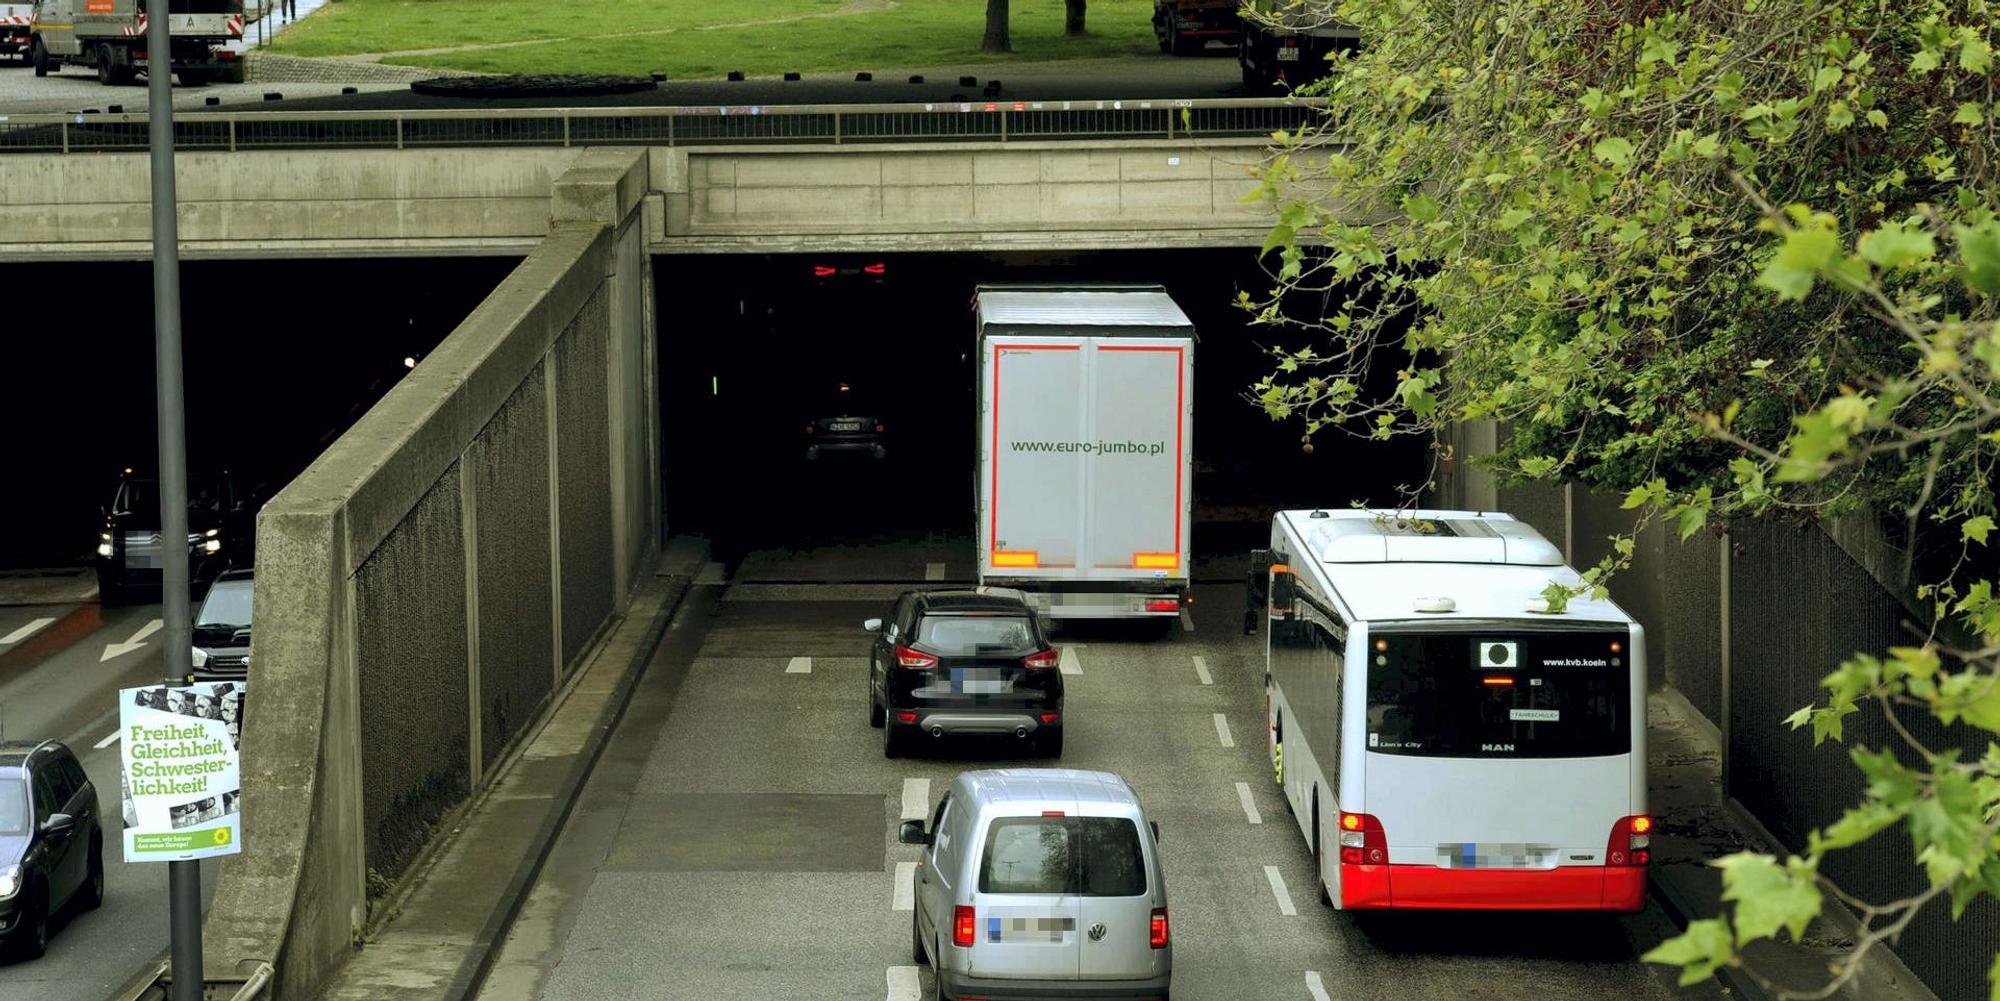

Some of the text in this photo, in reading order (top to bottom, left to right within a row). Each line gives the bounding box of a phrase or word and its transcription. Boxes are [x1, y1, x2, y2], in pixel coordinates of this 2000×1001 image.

[1011, 440, 1165, 455] www.euro-jumbo.pl
[1543, 659, 1606, 667] www.kvb.koeln
[130, 723, 208, 740] Freiheit,
[130, 738, 227, 759] Gleichheit,
[131, 759, 232, 777] Schwester-
[132, 775, 207, 795] lichkeit!
